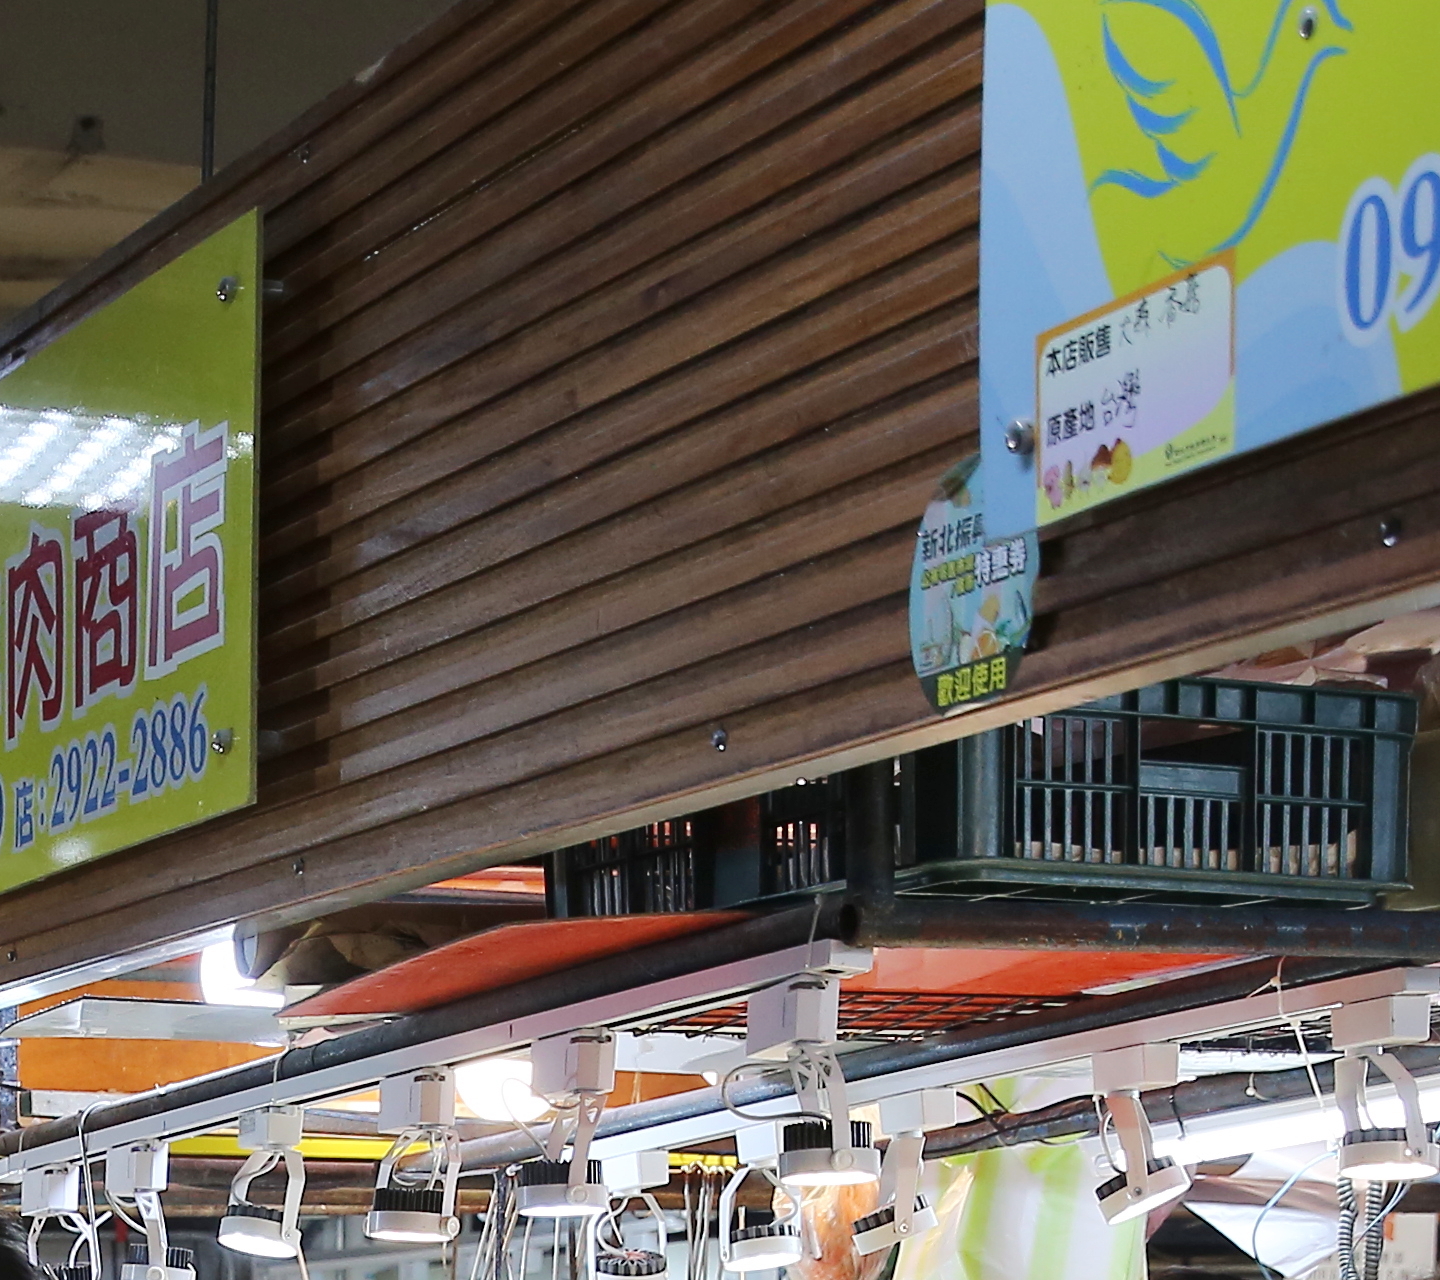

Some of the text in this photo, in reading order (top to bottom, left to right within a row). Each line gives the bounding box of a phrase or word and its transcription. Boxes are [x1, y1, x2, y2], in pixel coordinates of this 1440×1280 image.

[1046, 324, 1111, 378] 本店販售
[1046, 400, 1096, 449] 原產地
[937, 656, 1007, 707] 歡迎使用
